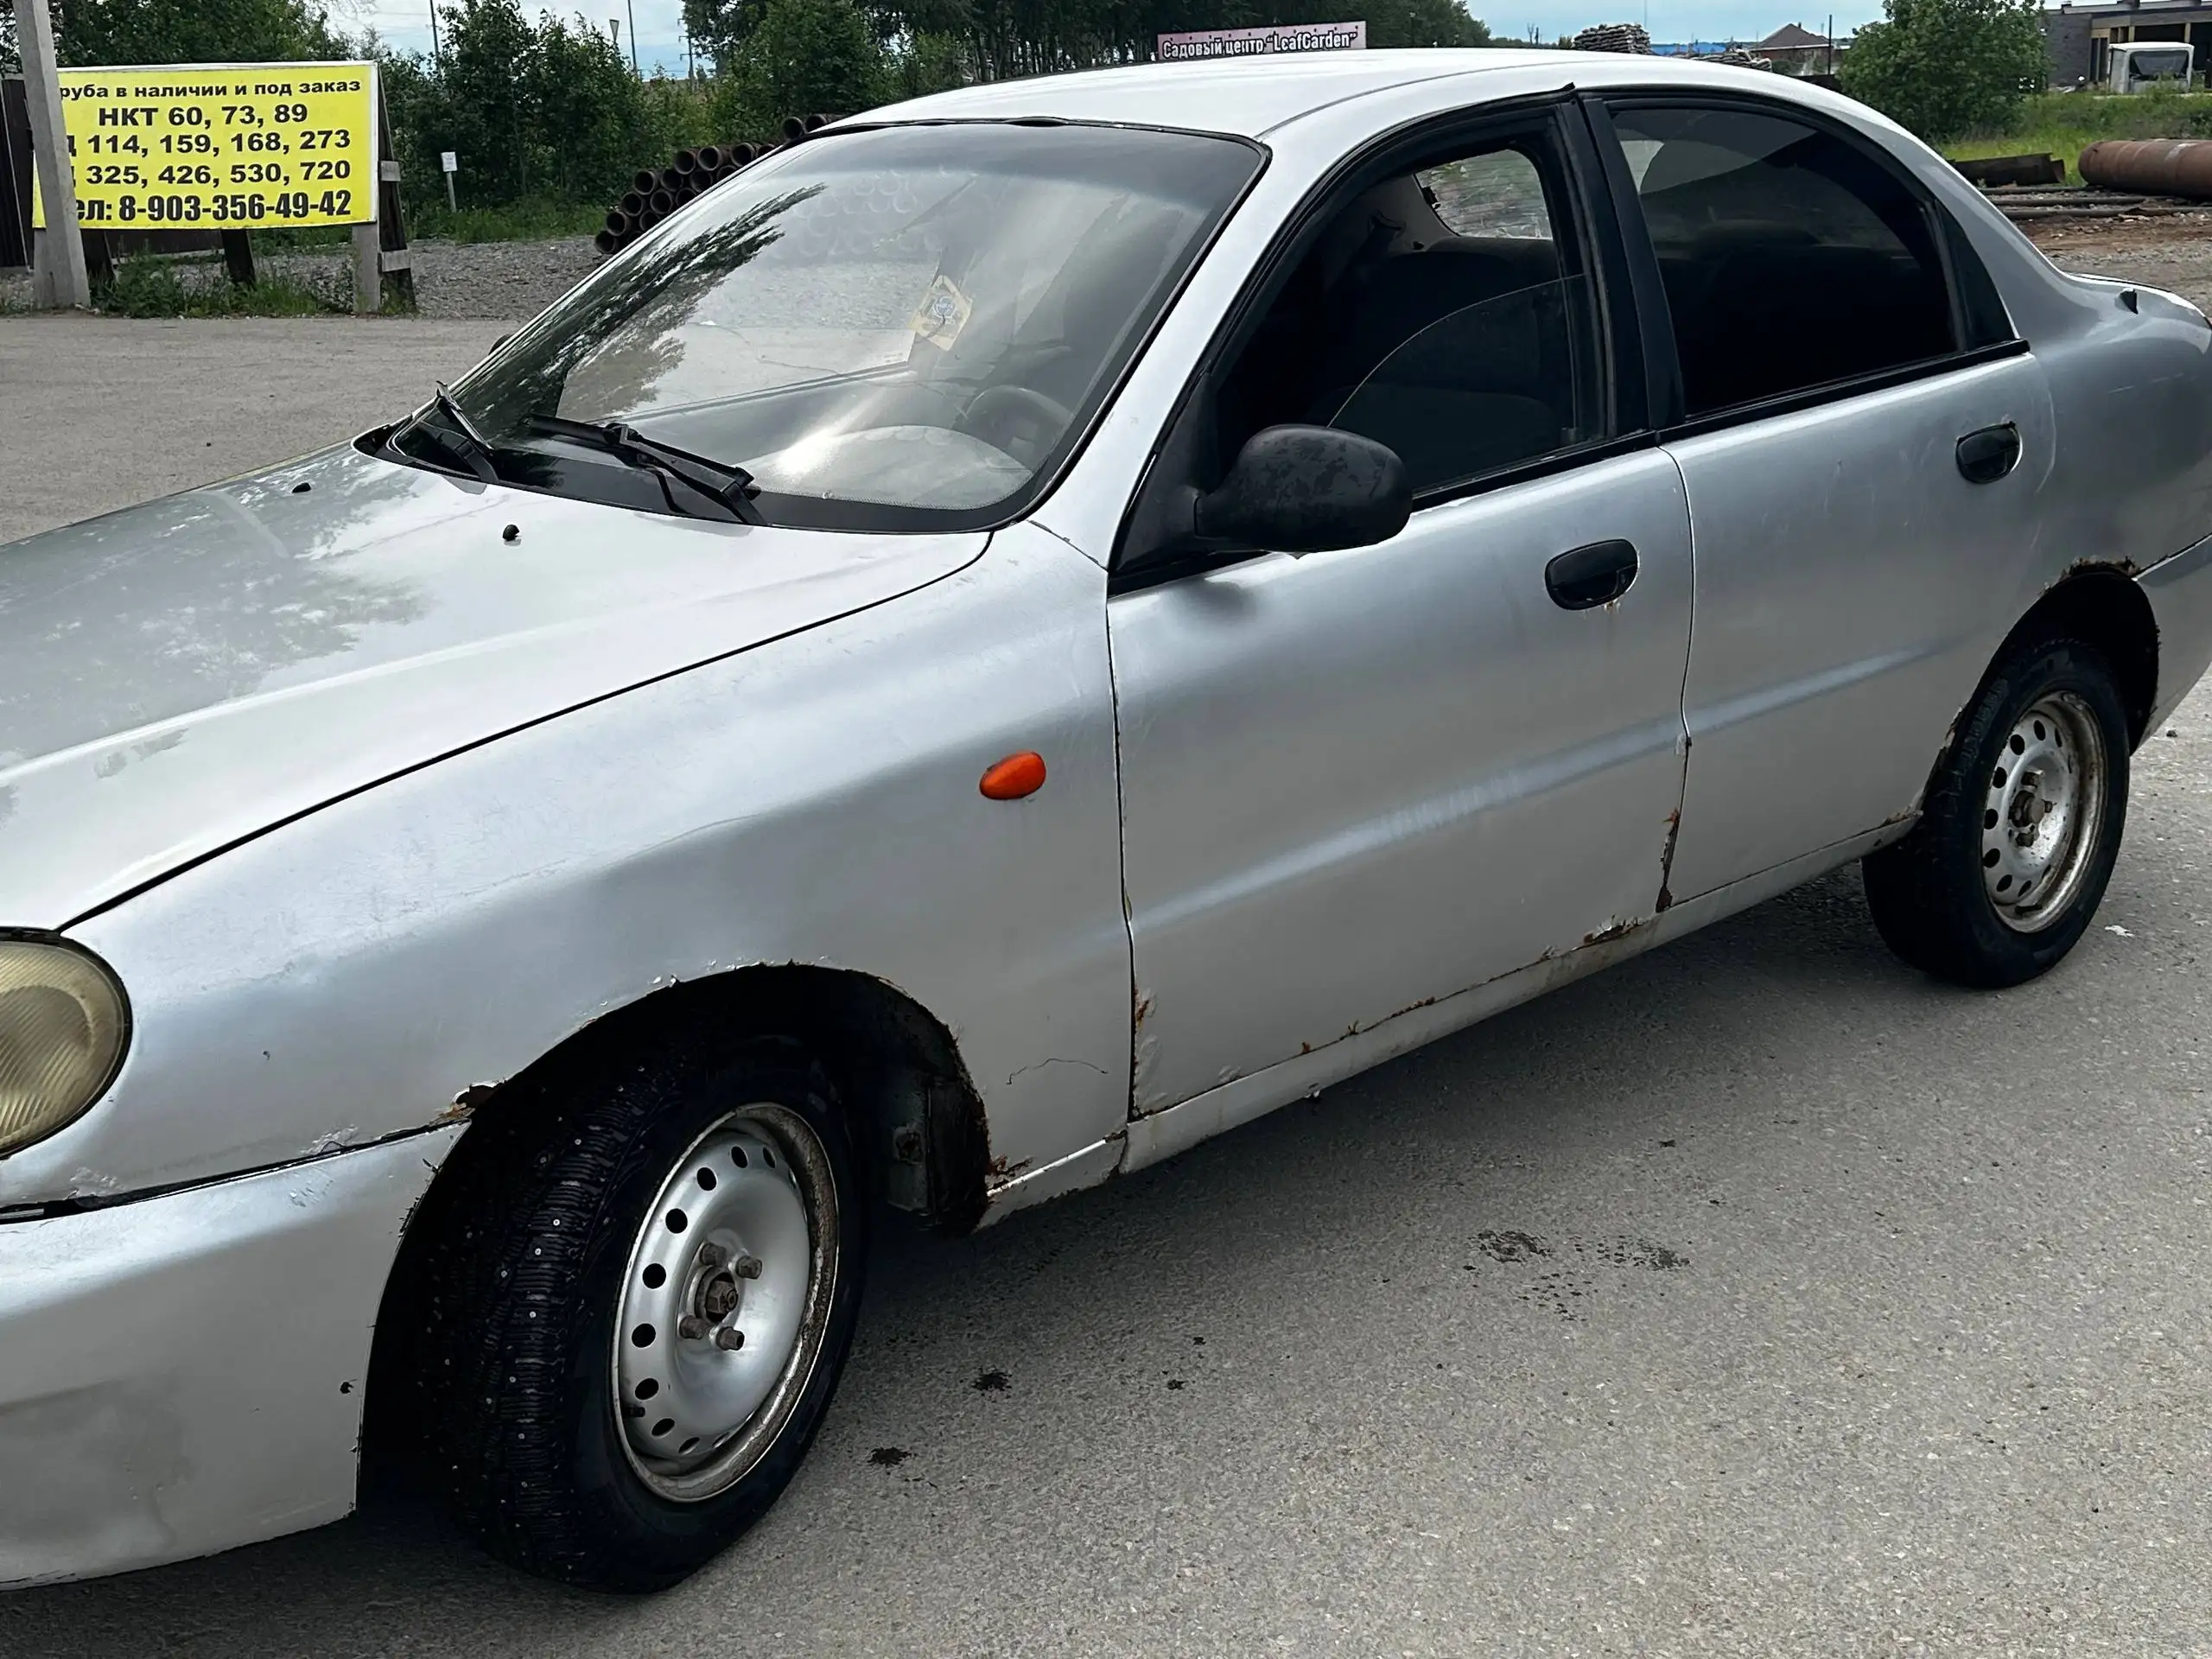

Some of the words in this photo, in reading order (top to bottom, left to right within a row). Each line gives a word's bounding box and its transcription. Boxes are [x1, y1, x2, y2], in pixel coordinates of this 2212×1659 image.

[1163, 37, 1223, 59] Садовый
[1224, 38, 1264, 55] центр
[60, 84, 108, 100] руба
[116, 87, 127, 97] в
[135, 85, 226, 98] наличии
[235, 85, 246, 95] и
[254, 83, 292, 96] под
[299, 80, 361, 93] заказ
[99, 107, 158, 126] НКТ
[168, 106, 211, 130] 60,
[221, 105, 264, 128] 73,
[274, 104, 308, 123] 89
[88, 135, 148, 158] 114,
[160, 134, 219, 157] 159,
[231, 132, 289, 155] 168,
[299, 130, 351, 149] 273
[86, 165, 148, 188] 325,
[158, 165, 219, 188] 426,
[230, 162, 289, 186] 530,
[299, 160, 351, 181] 720
[76, 199, 112, 220] ел:
[119, 189, 351, 221] 8-903-356-49-42
